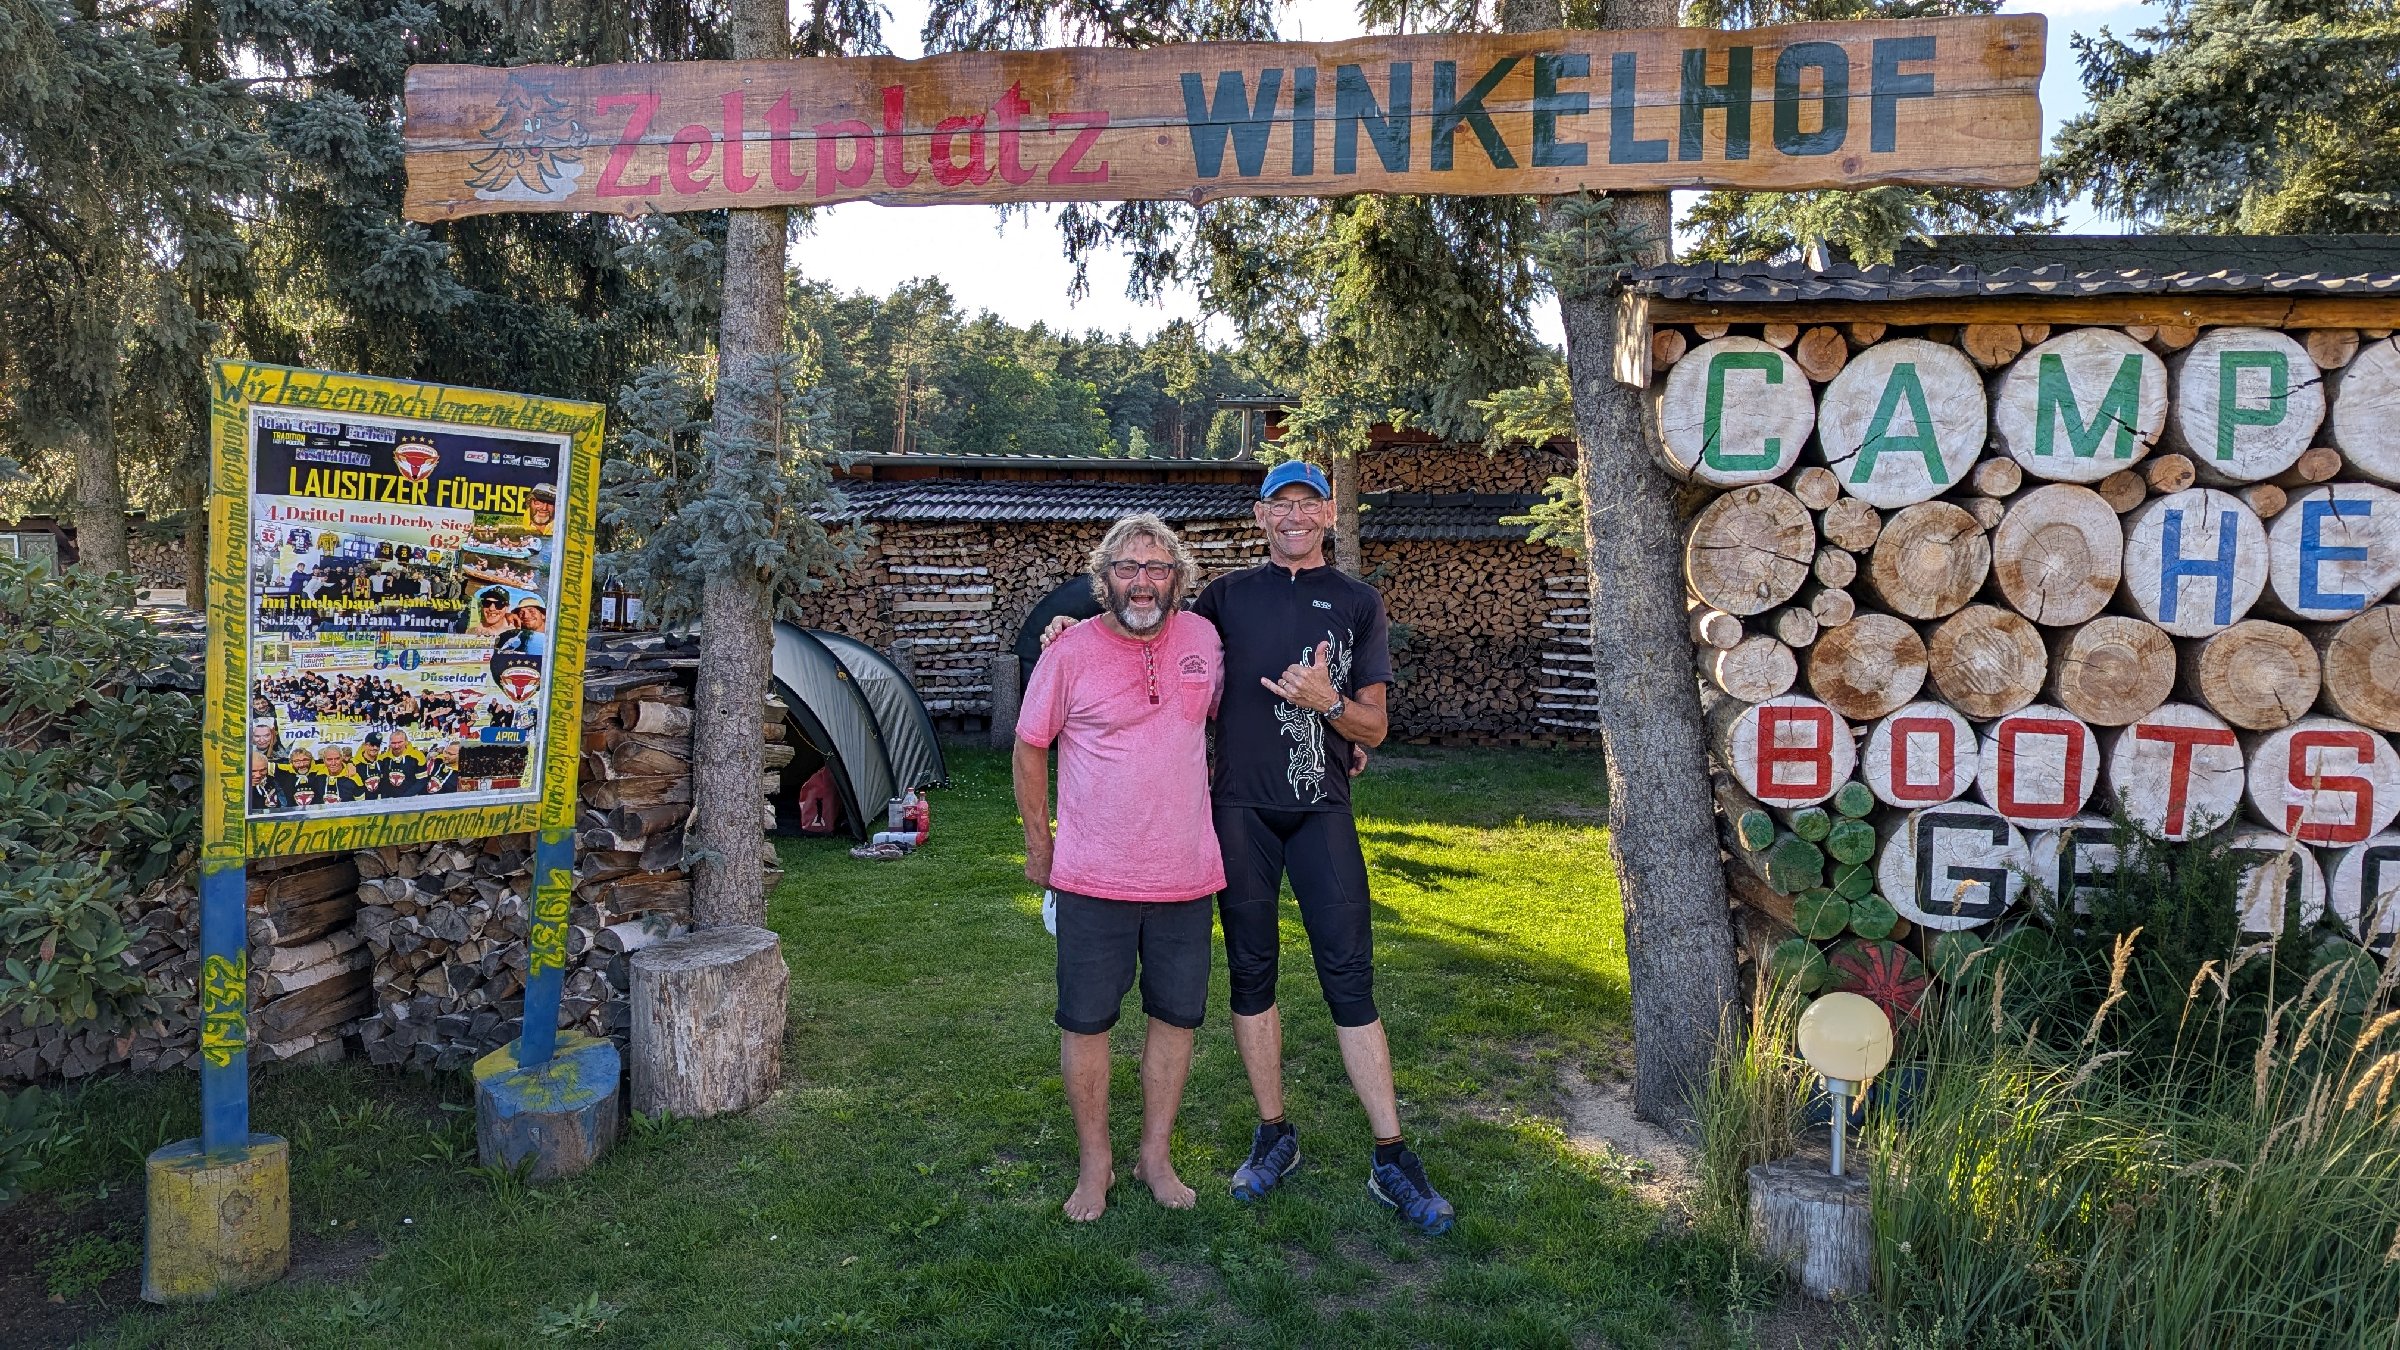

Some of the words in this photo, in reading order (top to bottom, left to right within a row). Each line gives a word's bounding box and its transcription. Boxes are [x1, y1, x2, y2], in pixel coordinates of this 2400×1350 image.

[599, 79, 1110, 197] Zeltplatz
[1181, 35, 1936, 177] WINKELHOF
[213, 362, 276, 403] Wir
[1702, 350, 2289, 485] CAMP
[273, 432, 306, 442] TRADITION
[289, 466, 429, 505] LAUSITZER
[436, 476, 532, 514] FÜCHSE
[349, 513, 387, 526] nach
[429, 533, 461, 549] 6:2
[2158, 499, 2372, 625] HE
[262, 594, 286, 609] im
[333, 612, 356, 627] bei
[360, 613, 397, 627] Fam.
[400, 613, 450, 628] Pinter
[420, 671, 488, 683] Düsseldorf
[285, 727, 320, 739] noch
[495, 731, 520, 742] APRIL
[1757, 705, 2375, 843] BOOTS
[249, 820, 292, 858] We
[202, 949, 247, 1068] 1932
